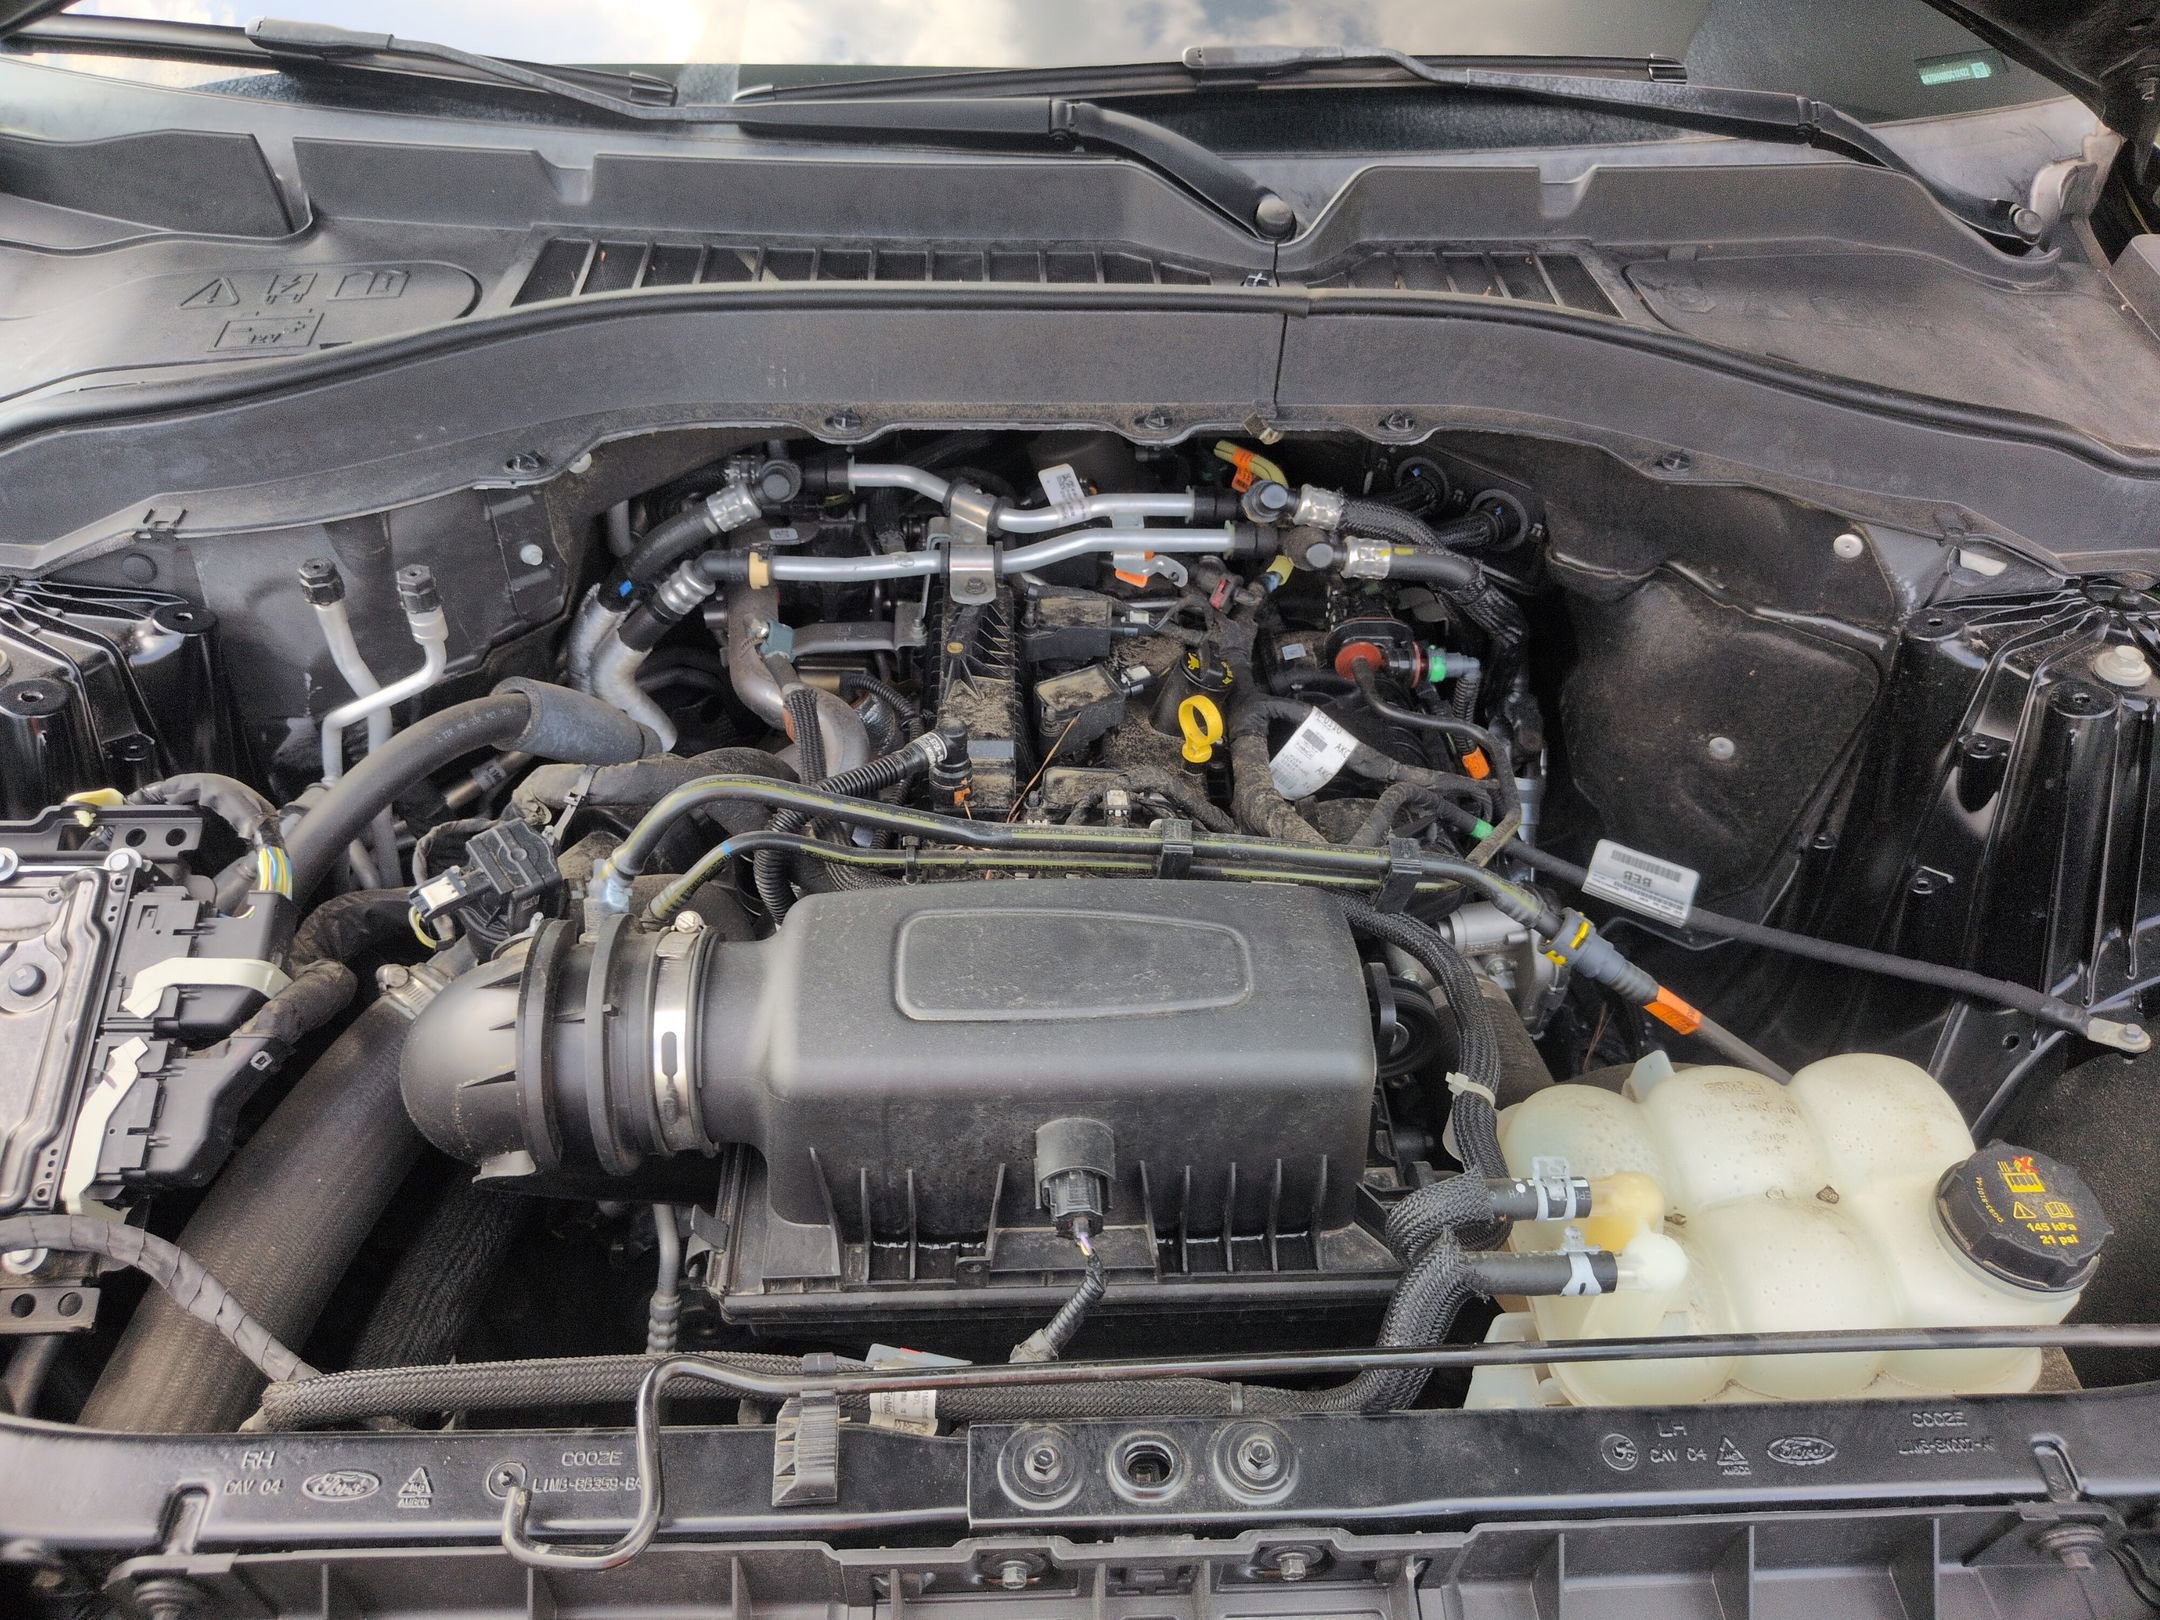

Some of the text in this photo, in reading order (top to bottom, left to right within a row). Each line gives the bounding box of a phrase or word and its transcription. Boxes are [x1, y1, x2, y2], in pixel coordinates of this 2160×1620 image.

[2026, 1221, 2078, 1232] 145 kPa
[2039, 1234, 2079, 1246] 21 psi
[1656, 1421, 1688, 1438] LH
[240, 1450, 277, 1470] RH
[1650, 1447, 1709, 1463] CAV 04
[223, 1478, 284, 1496] CAV 04
[310, 1473, 373, 1498] Ford
